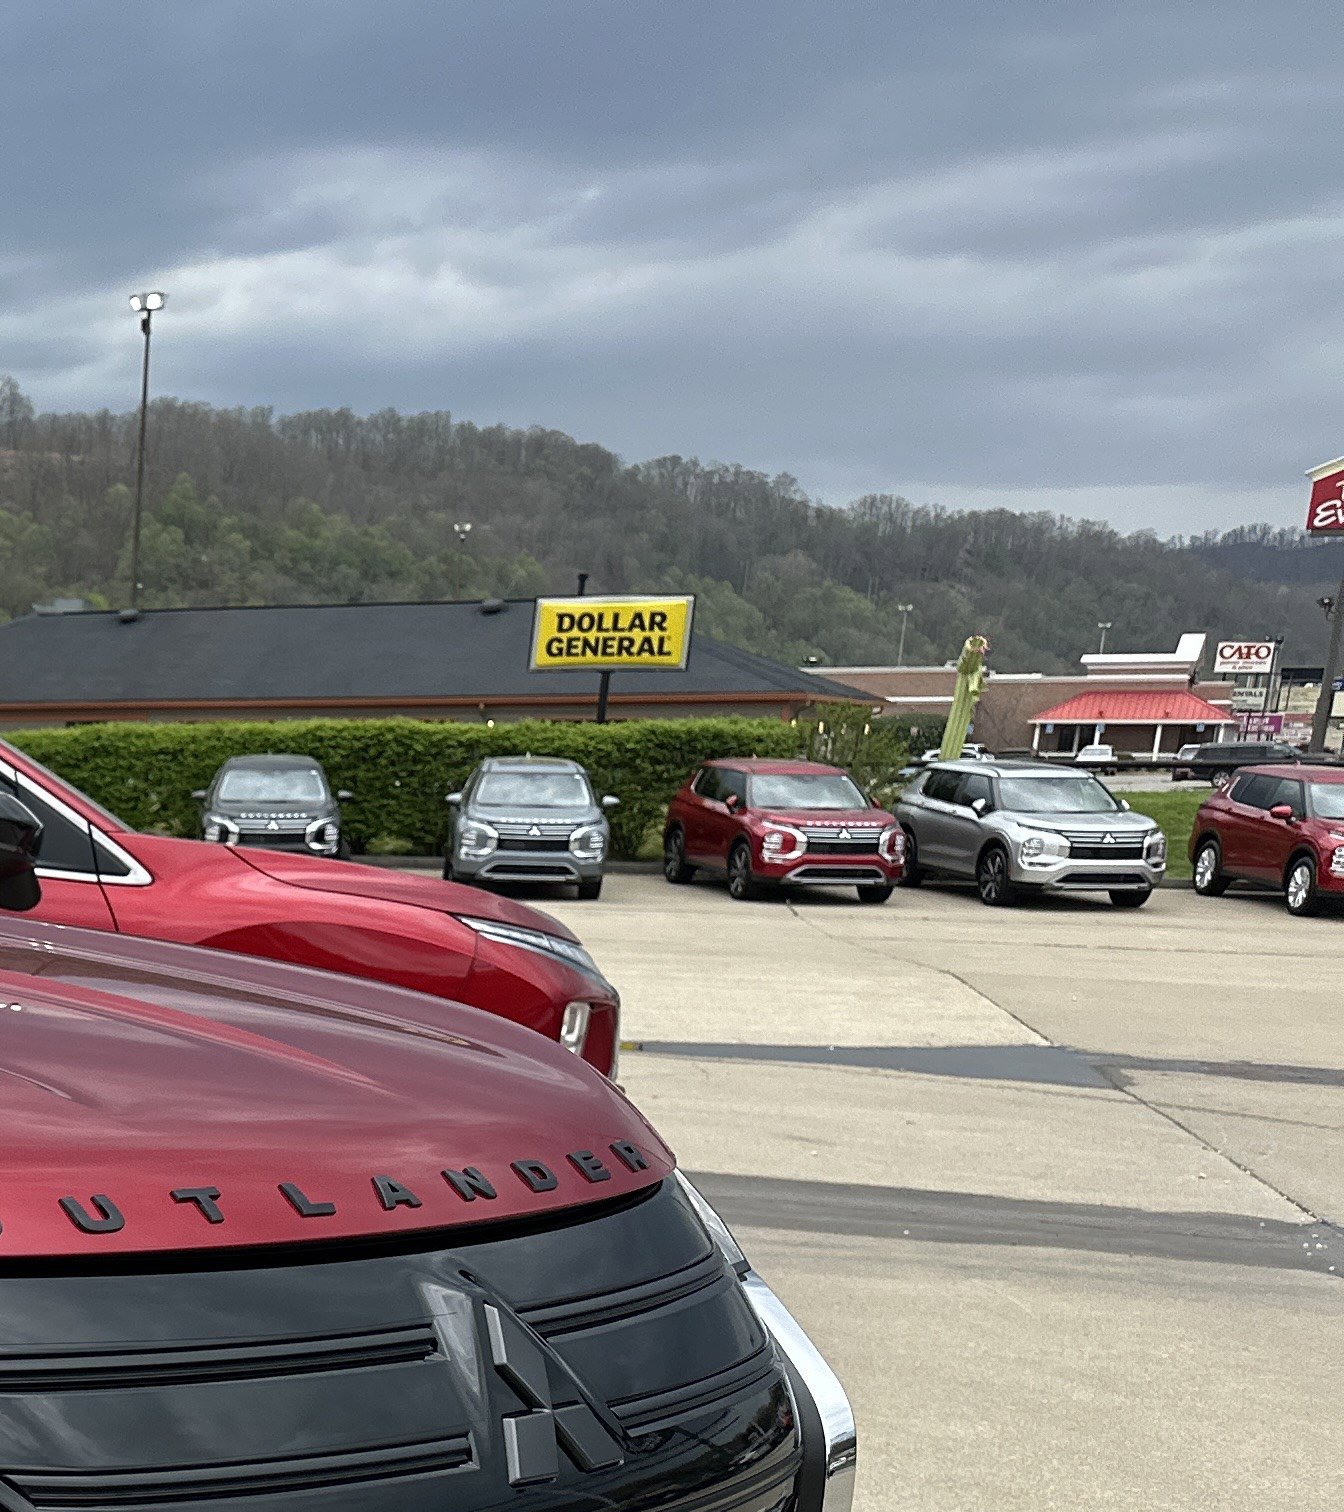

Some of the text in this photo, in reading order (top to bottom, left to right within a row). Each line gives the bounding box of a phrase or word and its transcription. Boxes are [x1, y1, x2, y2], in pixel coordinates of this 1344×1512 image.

[556, 611, 668, 634] DOLLAR
[545, 635, 672, 658] GENERAL
[1219, 645, 1271, 659] CATO
